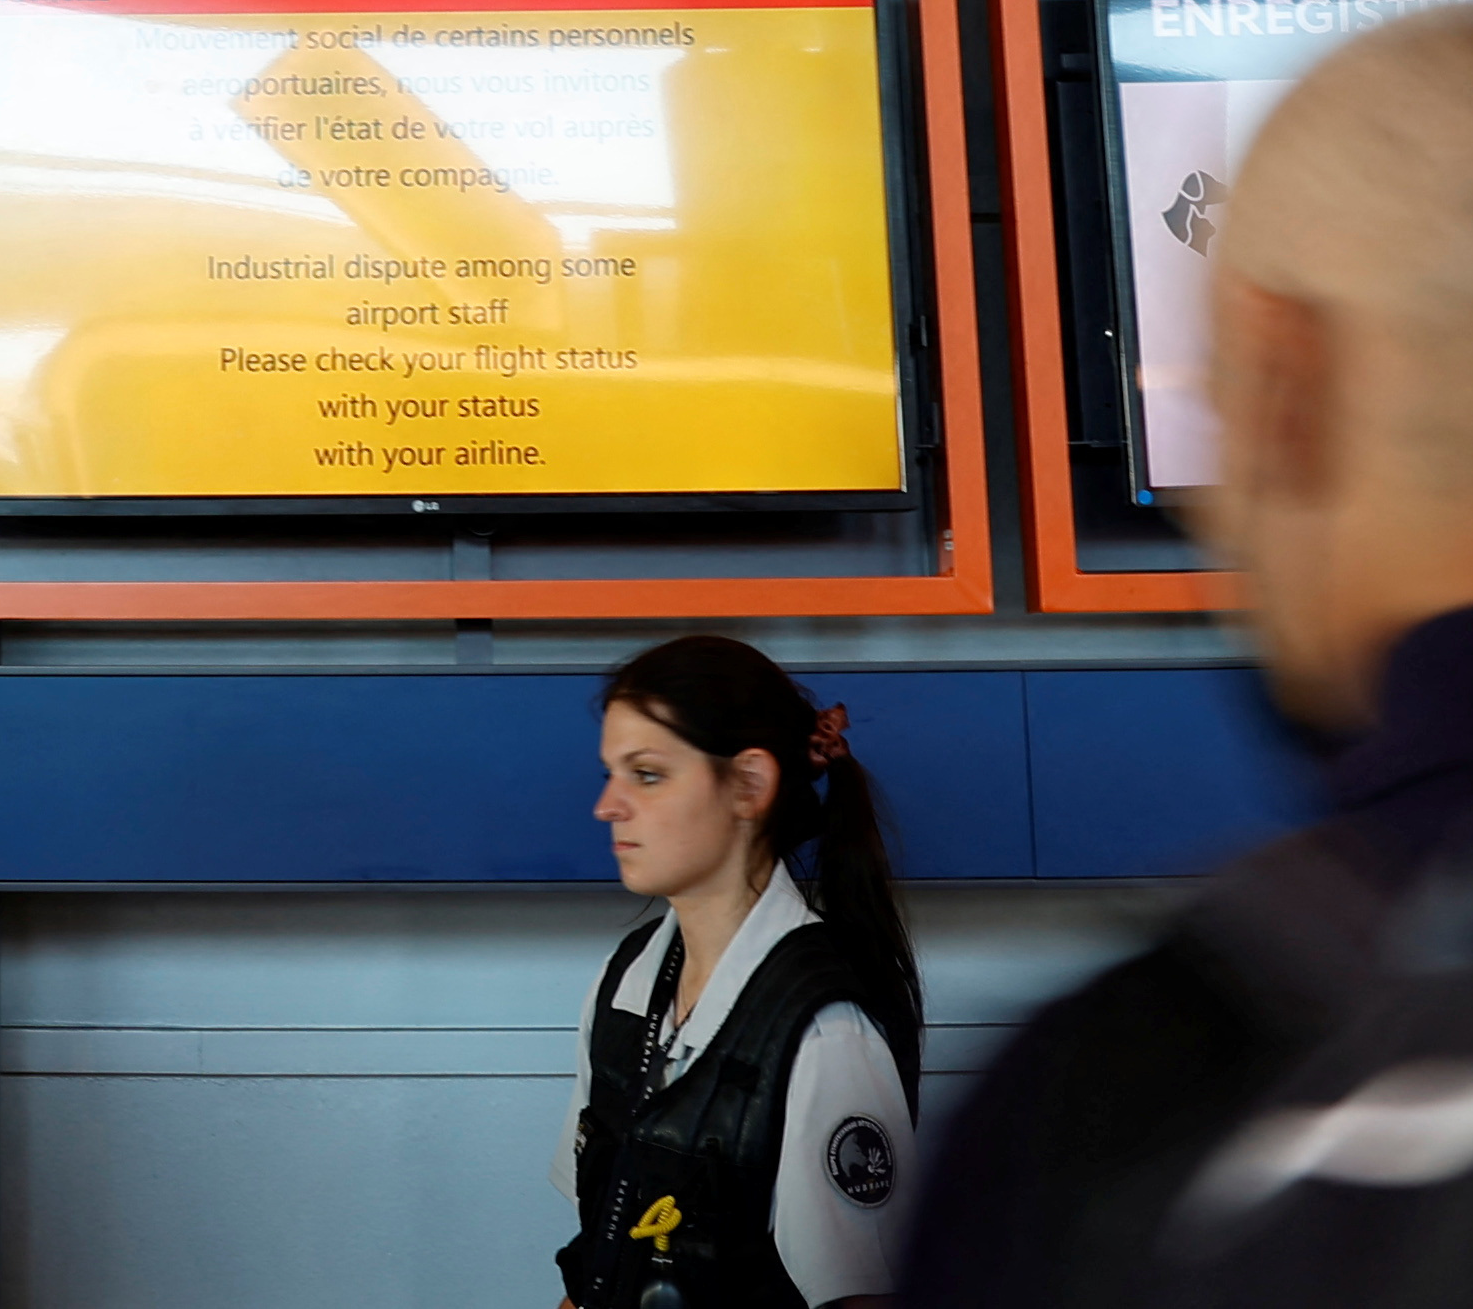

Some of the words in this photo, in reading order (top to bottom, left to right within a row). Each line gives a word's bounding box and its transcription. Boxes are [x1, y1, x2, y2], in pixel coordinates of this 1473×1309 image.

[136, 27, 297, 51] Mouvement
[306, 25, 384, 50] social
[391, 24, 427, 49] de
[433, 23, 541, 50] certains
[548, 21, 697, 50] personnels
[182, 71, 387, 101] aéroportuaires,
[189, 119, 204, 141] à
[212, 116, 306, 142] vérifier
[314, 115, 384, 141] l'état
[391, 115, 426, 140] de
[277, 164, 311, 188] de
[319, 167, 391, 189] votre
[399, 164, 559, 194] compagnie.
[207, 253, 335, 281] Industrial
[343, 252, 448, 287] dispute
[454, 257, 552, 286] among
[560, 257, 637, 278] some
[345, 299, 441, 334] airport
[447, 296, 511, 327] staff
[220, 346, 308, 373] Please
[314, 346, 397, 373] check
[402, 353, 466, 380] your
[473, 342, 548, 380] flight
[555, 346, 638, 373] status
[317, 391, 379, 420] with
[384, 398, 451, 427] your
[457, 393, 541, 419] status
[313, 438, 375, 467] with
[381, 446, 447, 475] your
[453, 438, 547, 467] airline.
